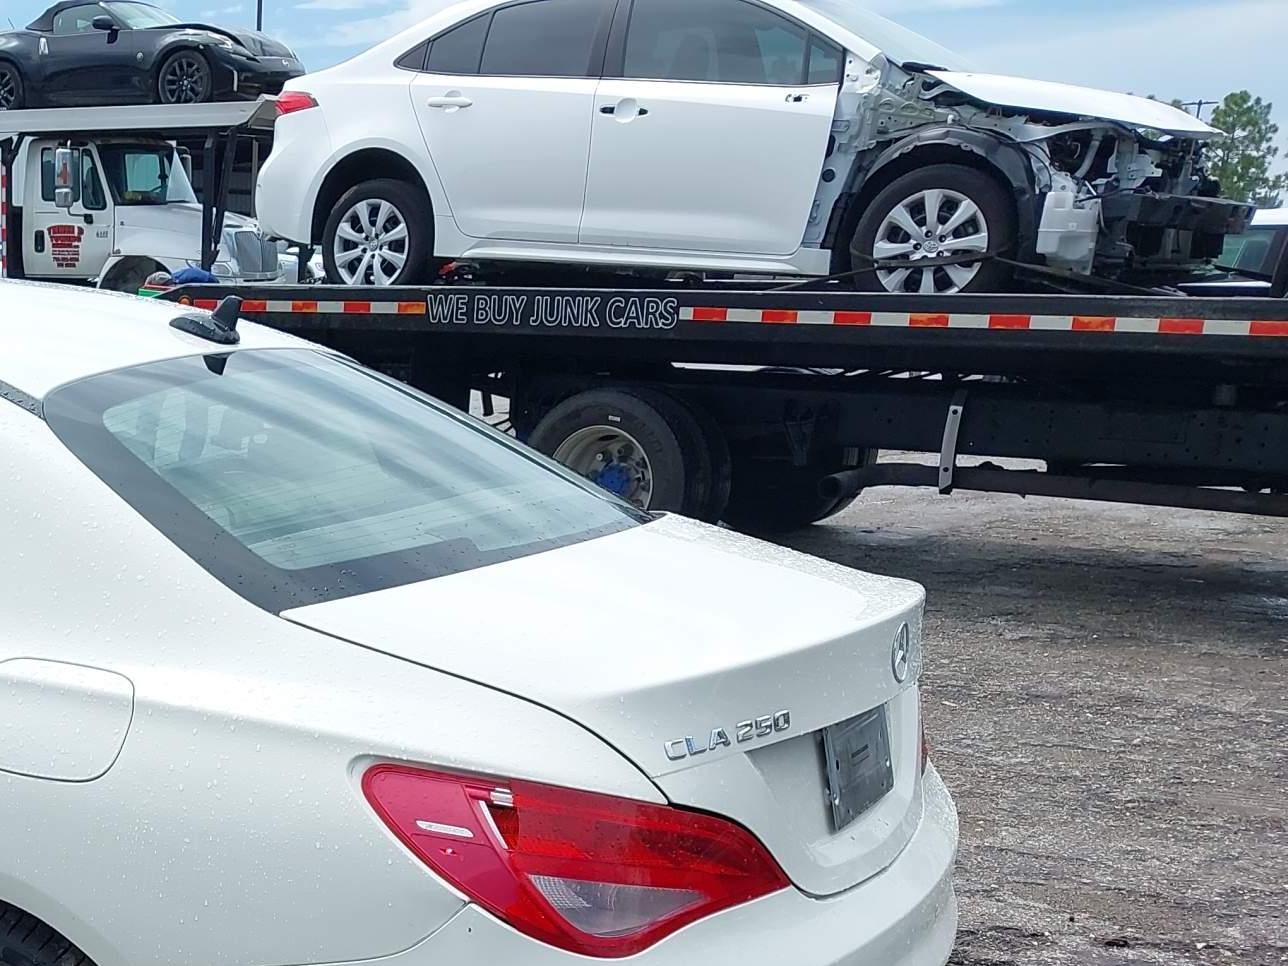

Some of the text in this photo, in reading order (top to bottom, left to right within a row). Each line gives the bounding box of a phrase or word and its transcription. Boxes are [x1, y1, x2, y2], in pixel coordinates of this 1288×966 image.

[427, 295, 678, 328] WE BUY JUNK CARS
[663, 709, 791, 761] CLA 250
